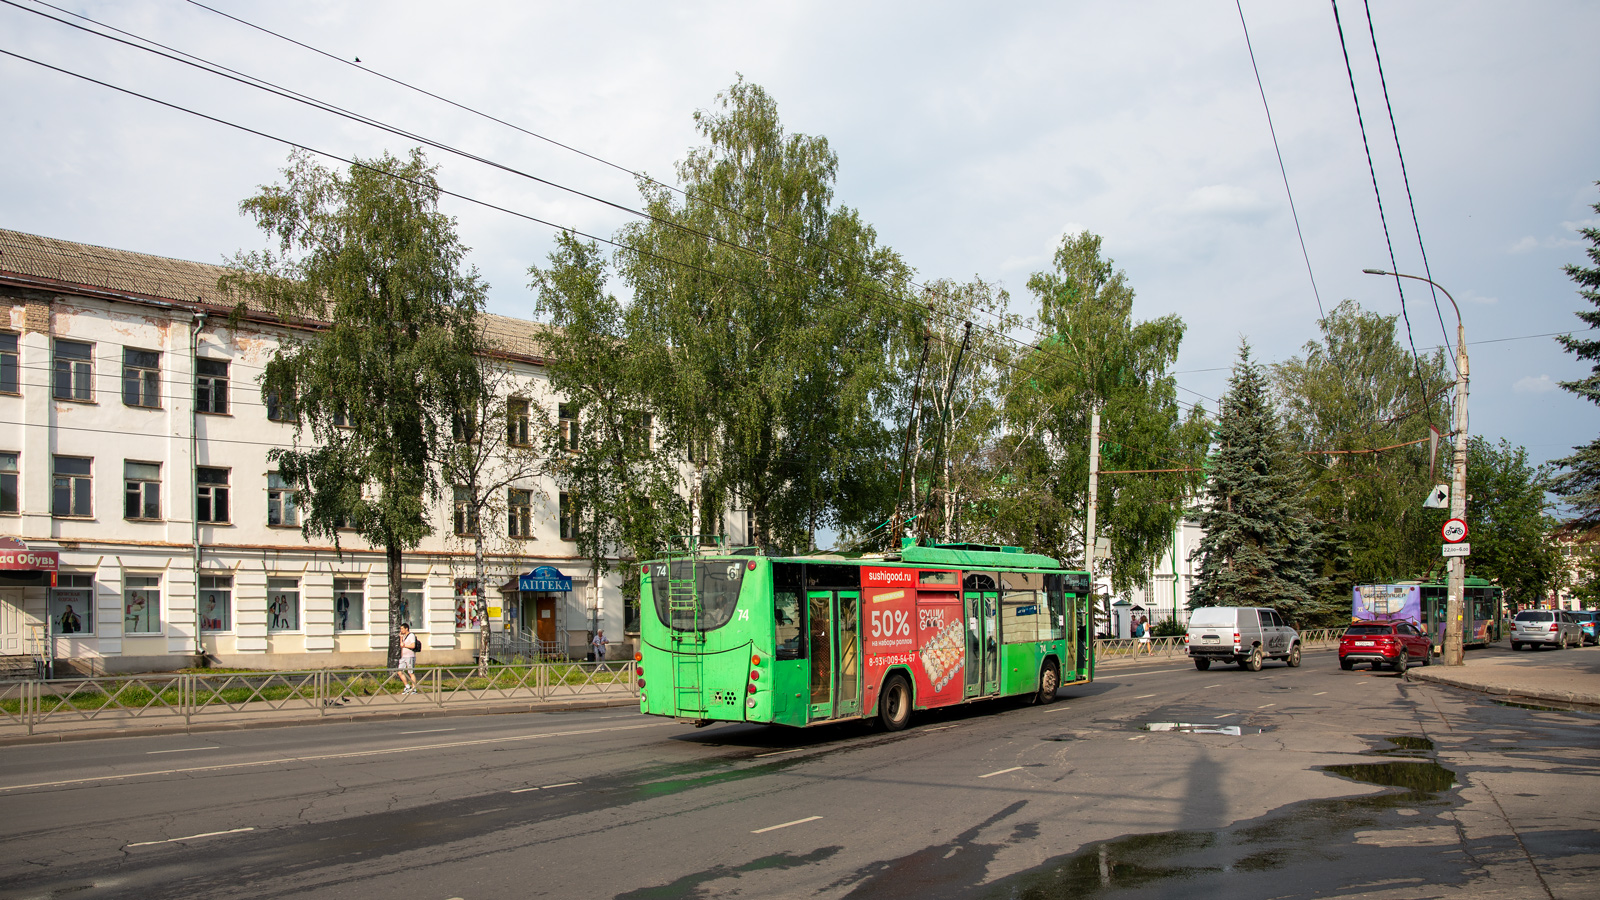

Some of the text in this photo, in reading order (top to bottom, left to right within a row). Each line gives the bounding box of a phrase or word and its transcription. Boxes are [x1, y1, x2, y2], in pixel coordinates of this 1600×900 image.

[17, 554, 55, 567] Обувь
[656, 565, 667, 577] 74
[868, 571, 911, 583] sushigood.ru
[521, 580, 571, 590] АПТЕКА
[737, 609, 749, 621] 74
[871, 610, 910, 637] 50%
[896, 639, 912, 647] роллов
[1040, 644, 1047, 653] 74
